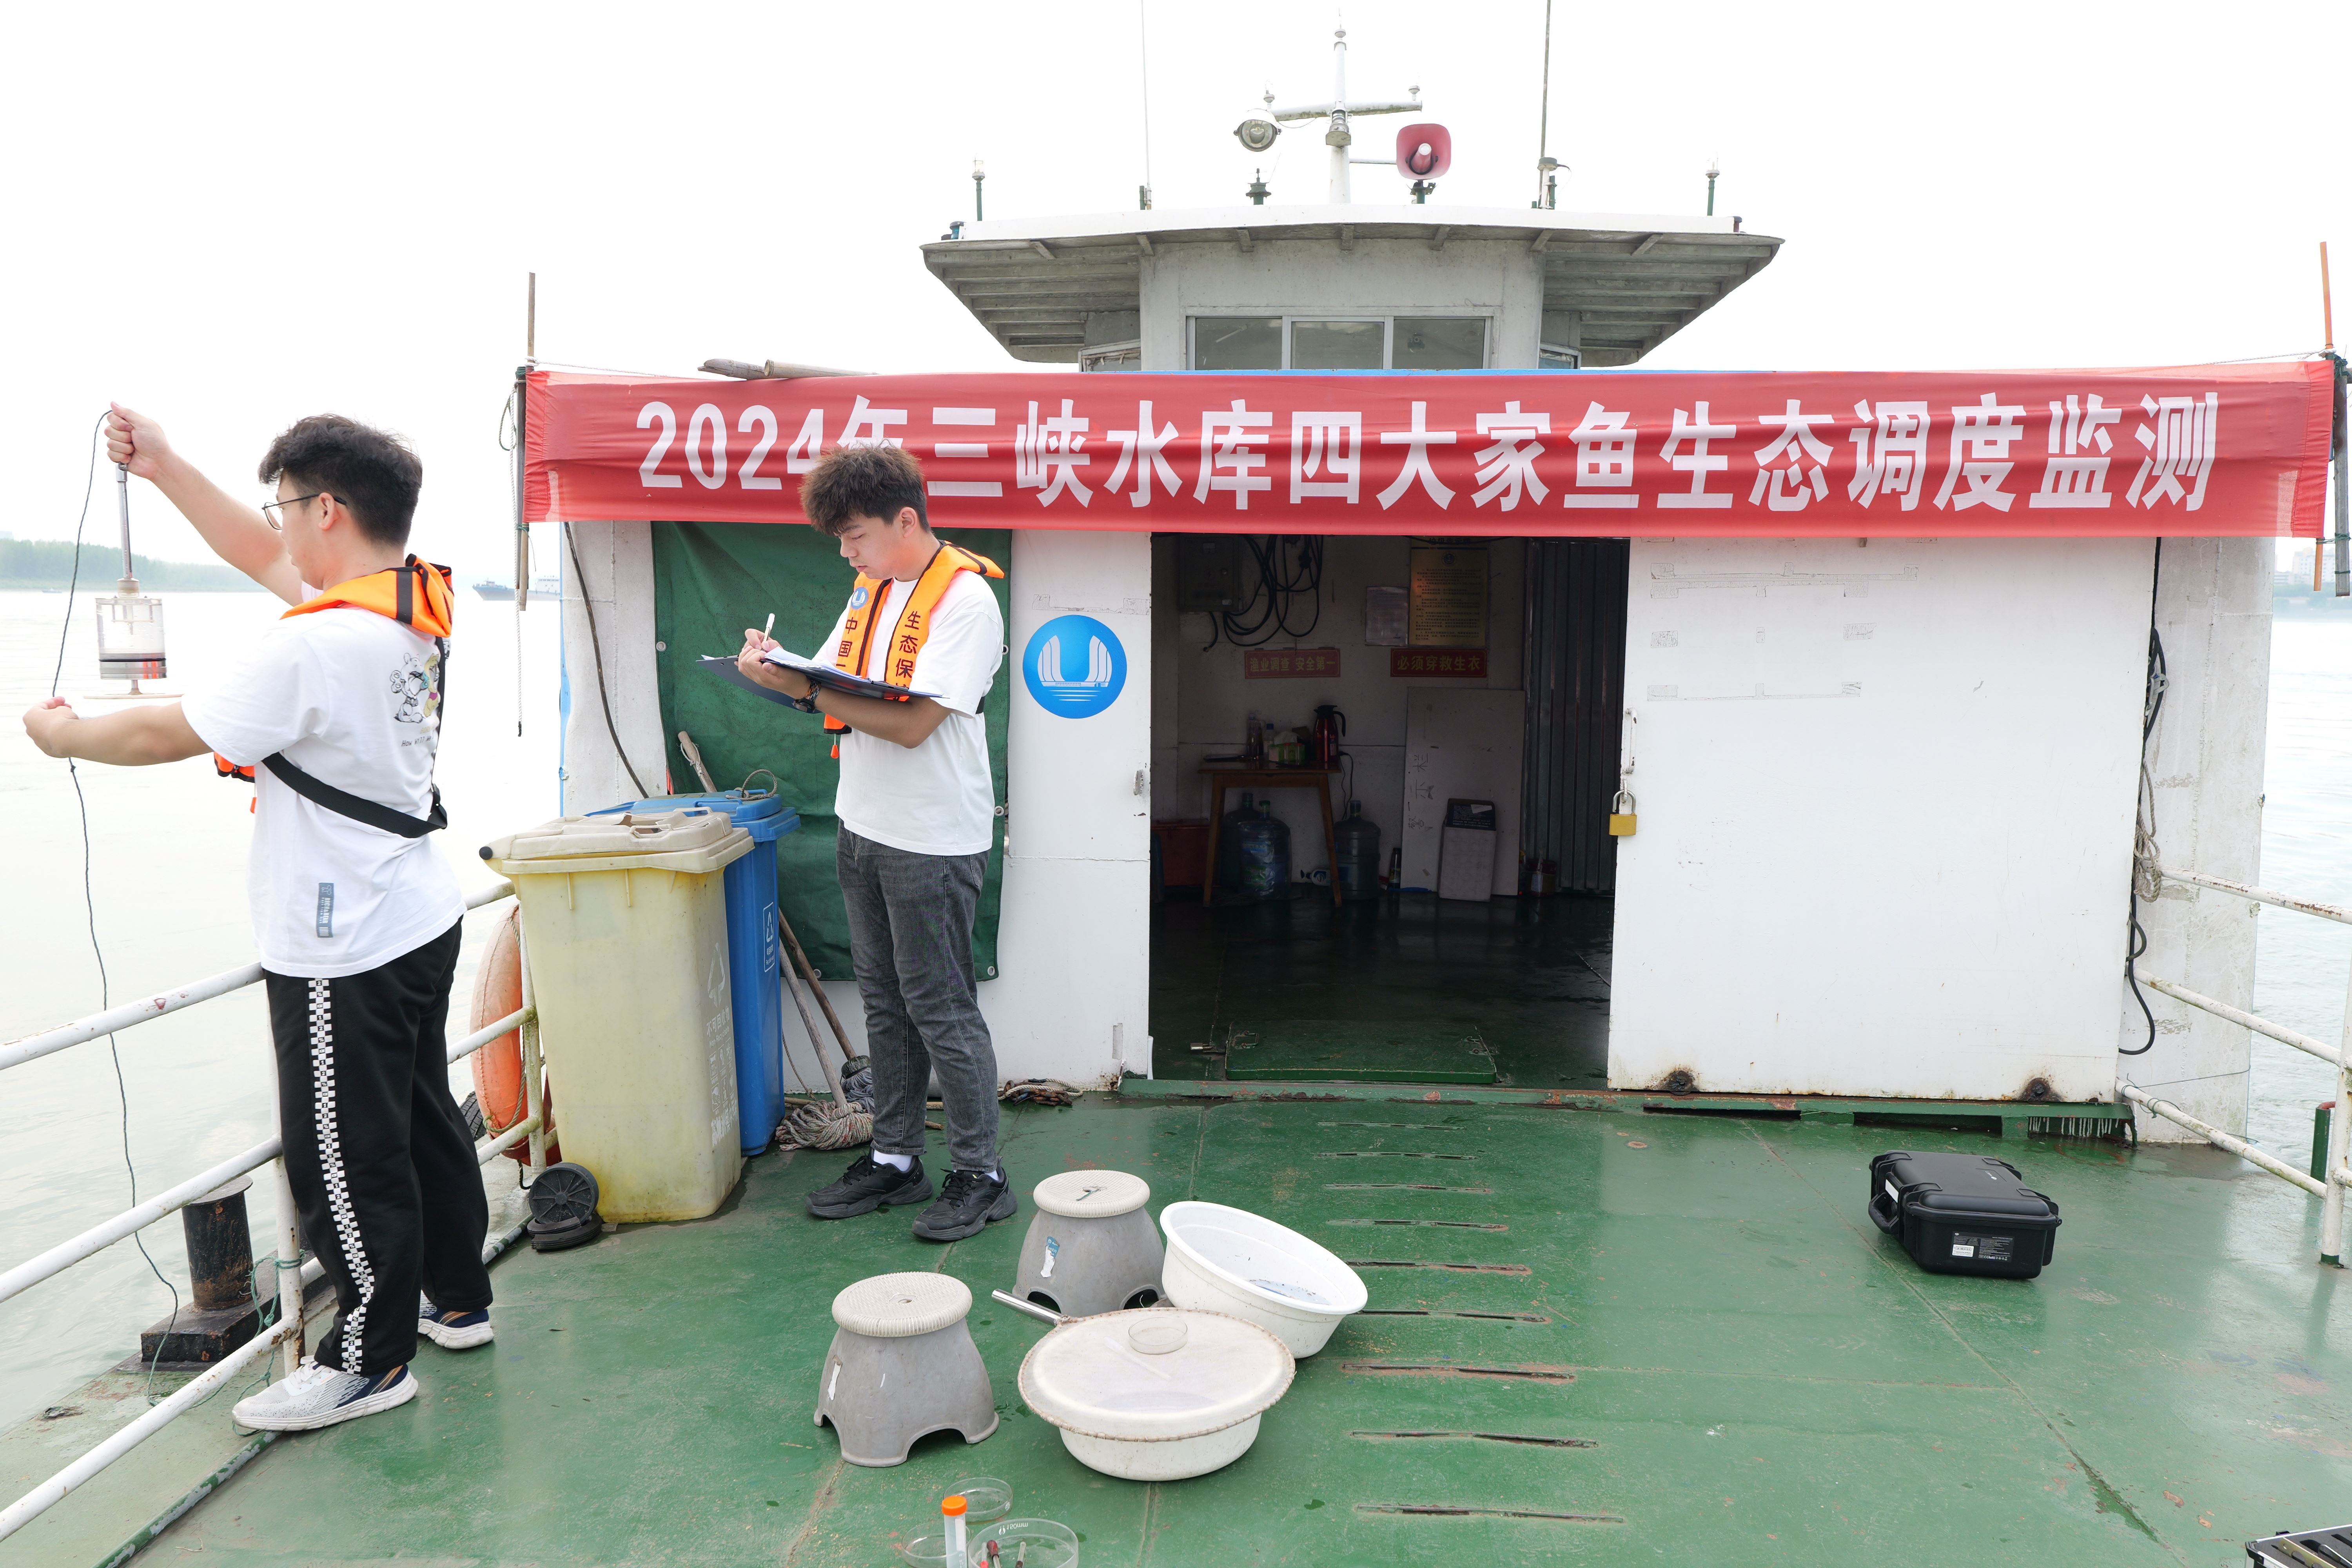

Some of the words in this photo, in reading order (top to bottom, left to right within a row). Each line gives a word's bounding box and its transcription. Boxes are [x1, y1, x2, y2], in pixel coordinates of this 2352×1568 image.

[836, 617, 858, 667] 中国
[896, 611, 920, 687] 生态保
[1250, 657, 1290, 672] 渔业调查
[1295, 655, 1336, 671] 安全第一
[1397, 655, 1481, 671] 必须穿救生衣
